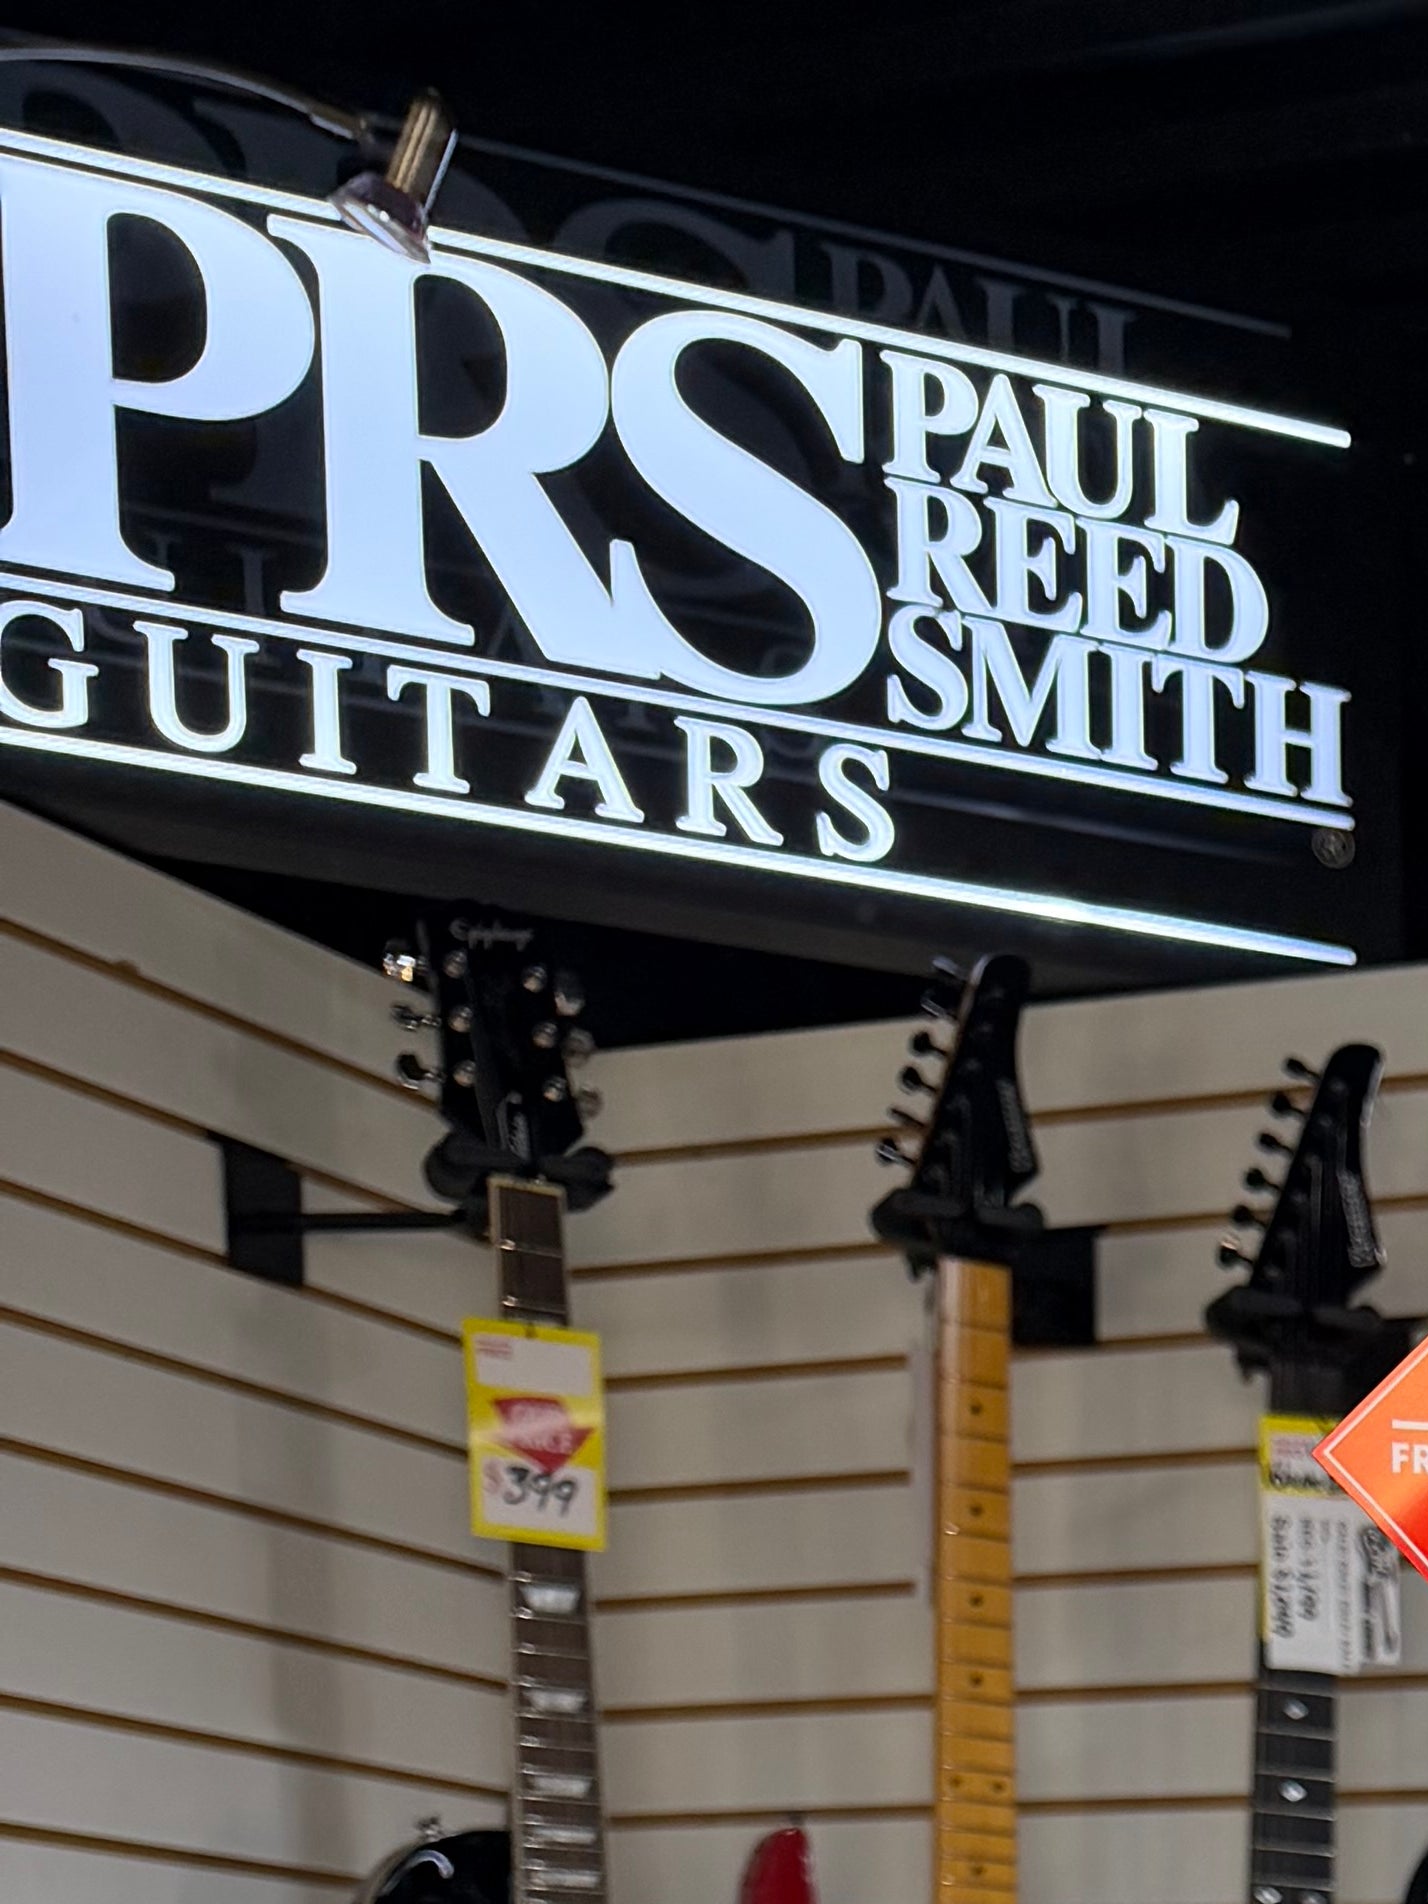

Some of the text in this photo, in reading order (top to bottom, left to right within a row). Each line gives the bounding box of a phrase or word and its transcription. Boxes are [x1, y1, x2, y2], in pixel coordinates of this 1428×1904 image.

[0, 153, 882, 706] PRS
[877, 348, 1240, 547] PAUL
[884, 473, 1270, 665] REED
[0, 600, 896, 864] GUITARS
[886, 606, 1354, 808] SMITH
